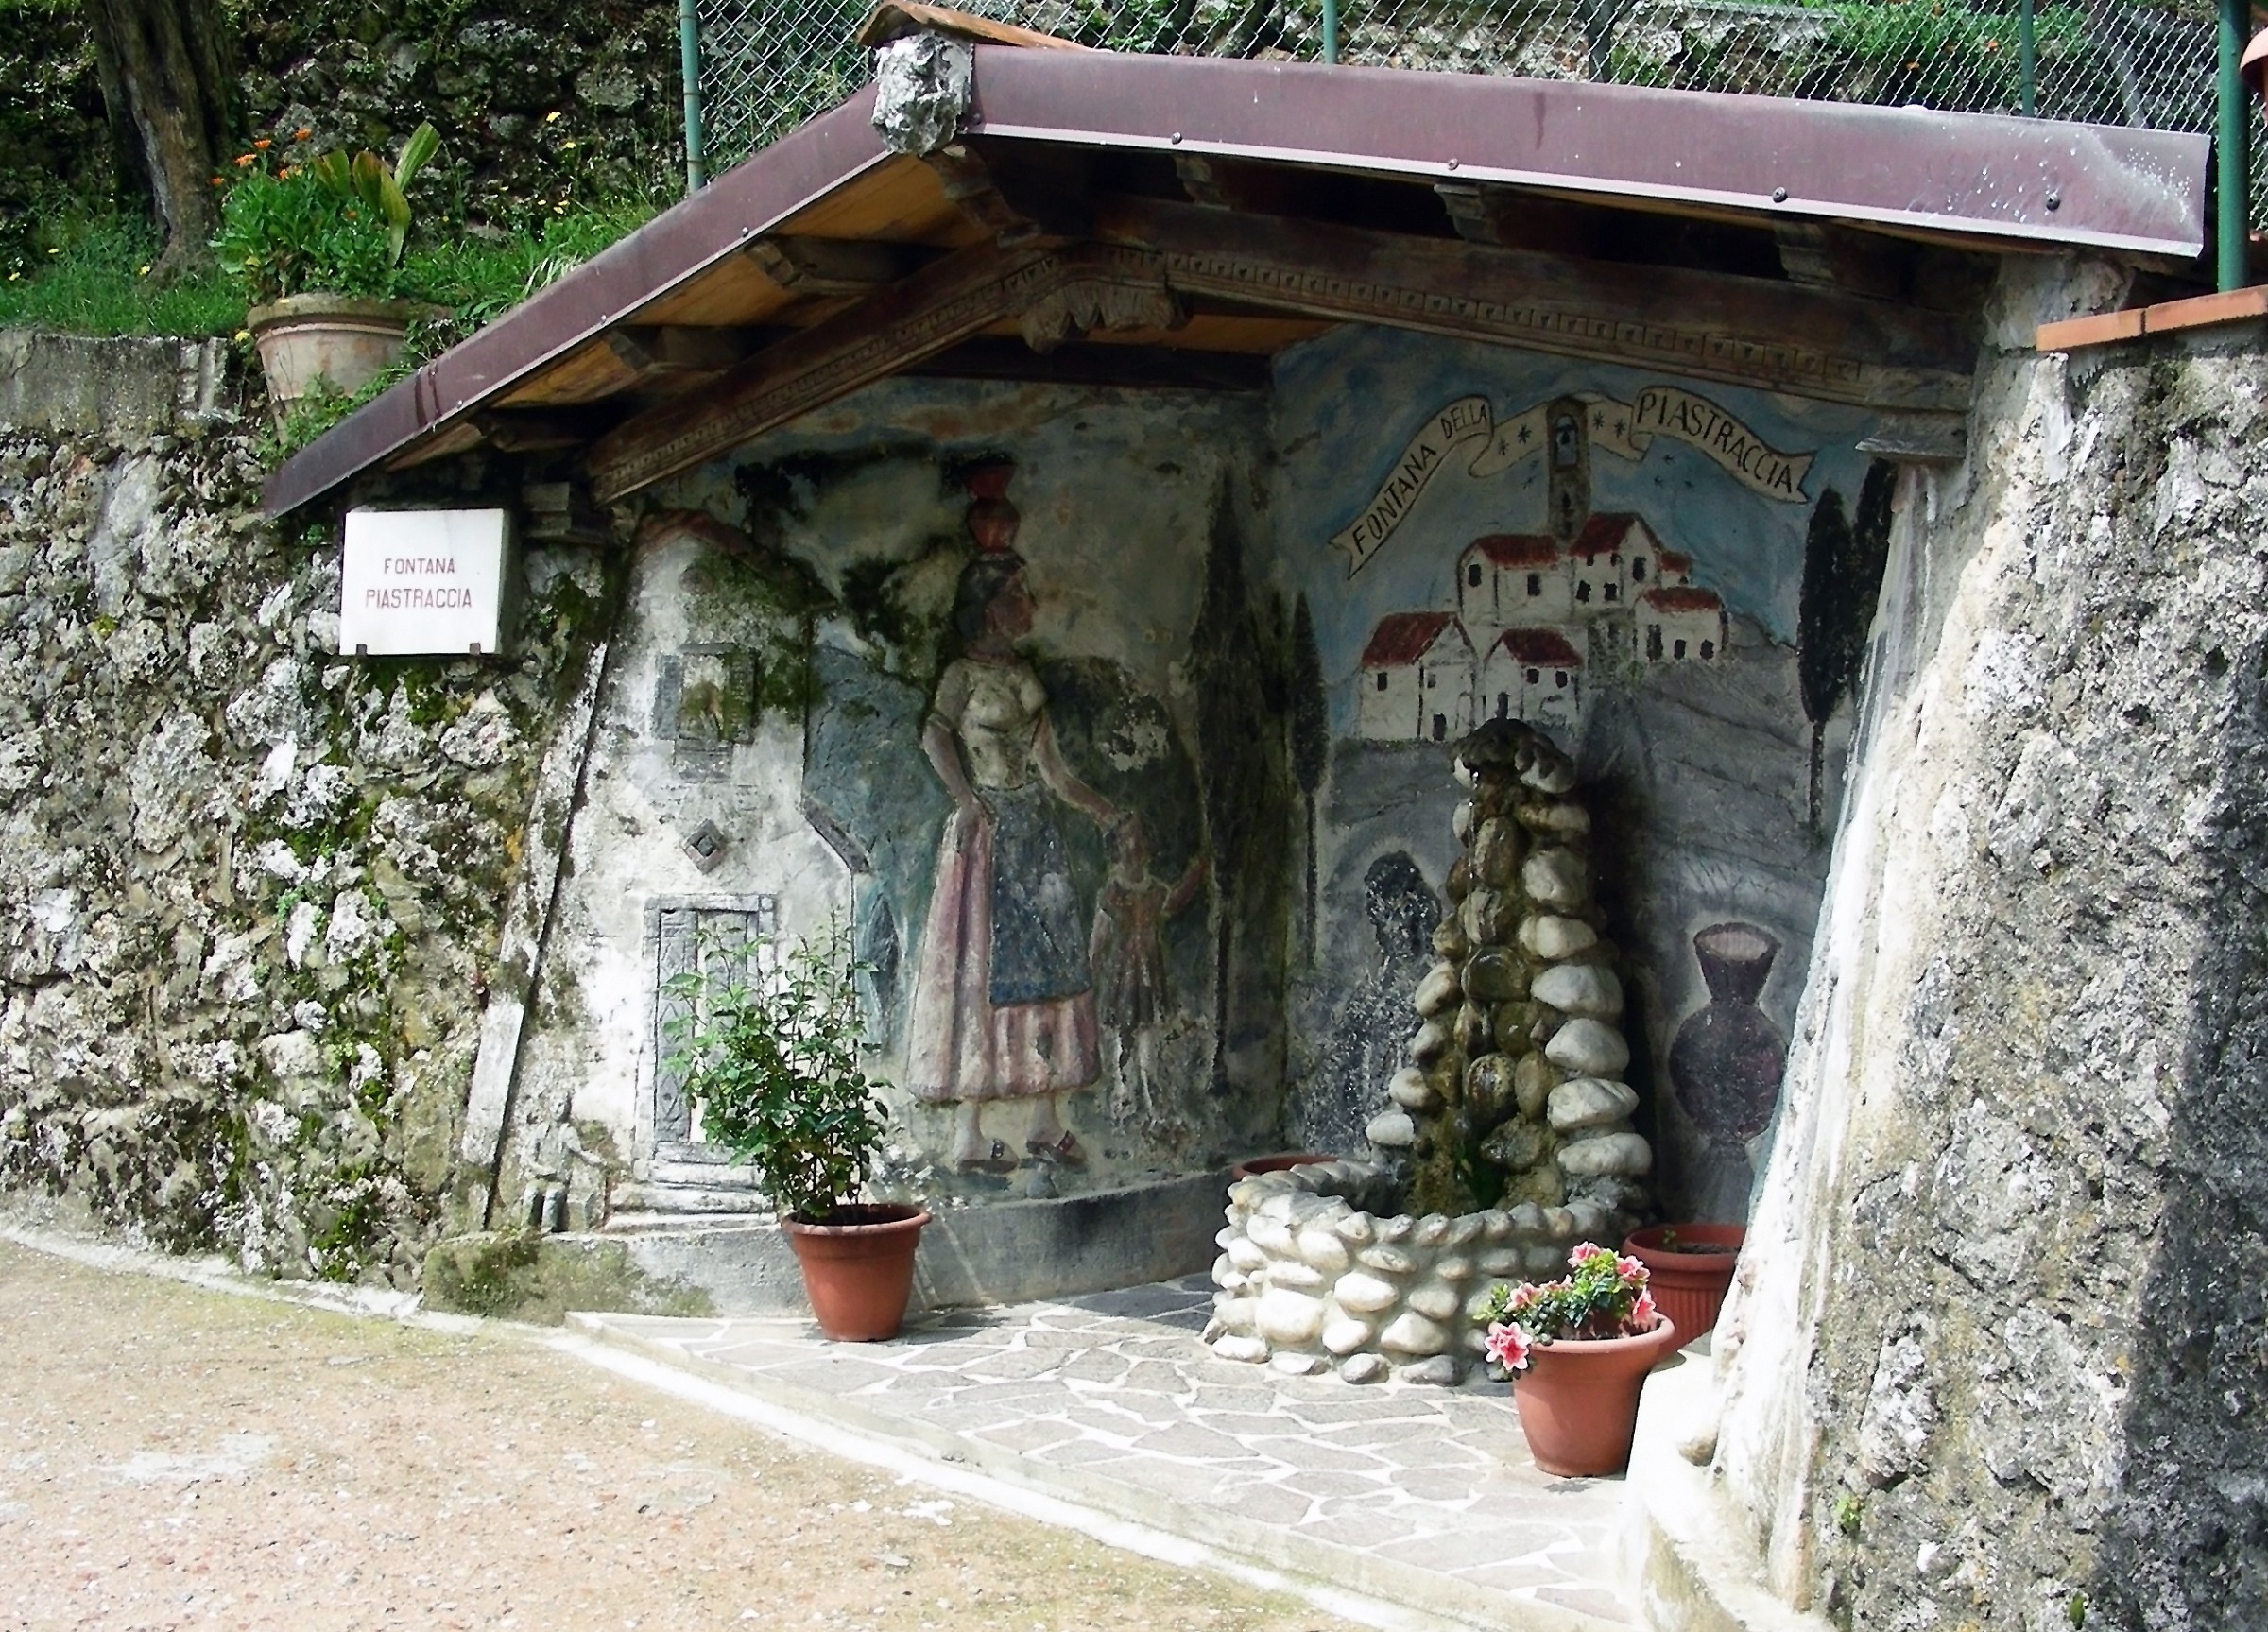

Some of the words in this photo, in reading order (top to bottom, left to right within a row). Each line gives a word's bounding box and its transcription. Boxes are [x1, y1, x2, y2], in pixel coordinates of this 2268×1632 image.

[1351, 443, 1437, 555] FONTANA
[1440, 404, 1488, 440] DELLA
[1637, 392, 1795, 494] PIASTRACCIA
[384, 558, 455, 575] FONTANA
[366, 588, 472, 609] PIASTRACCIA
